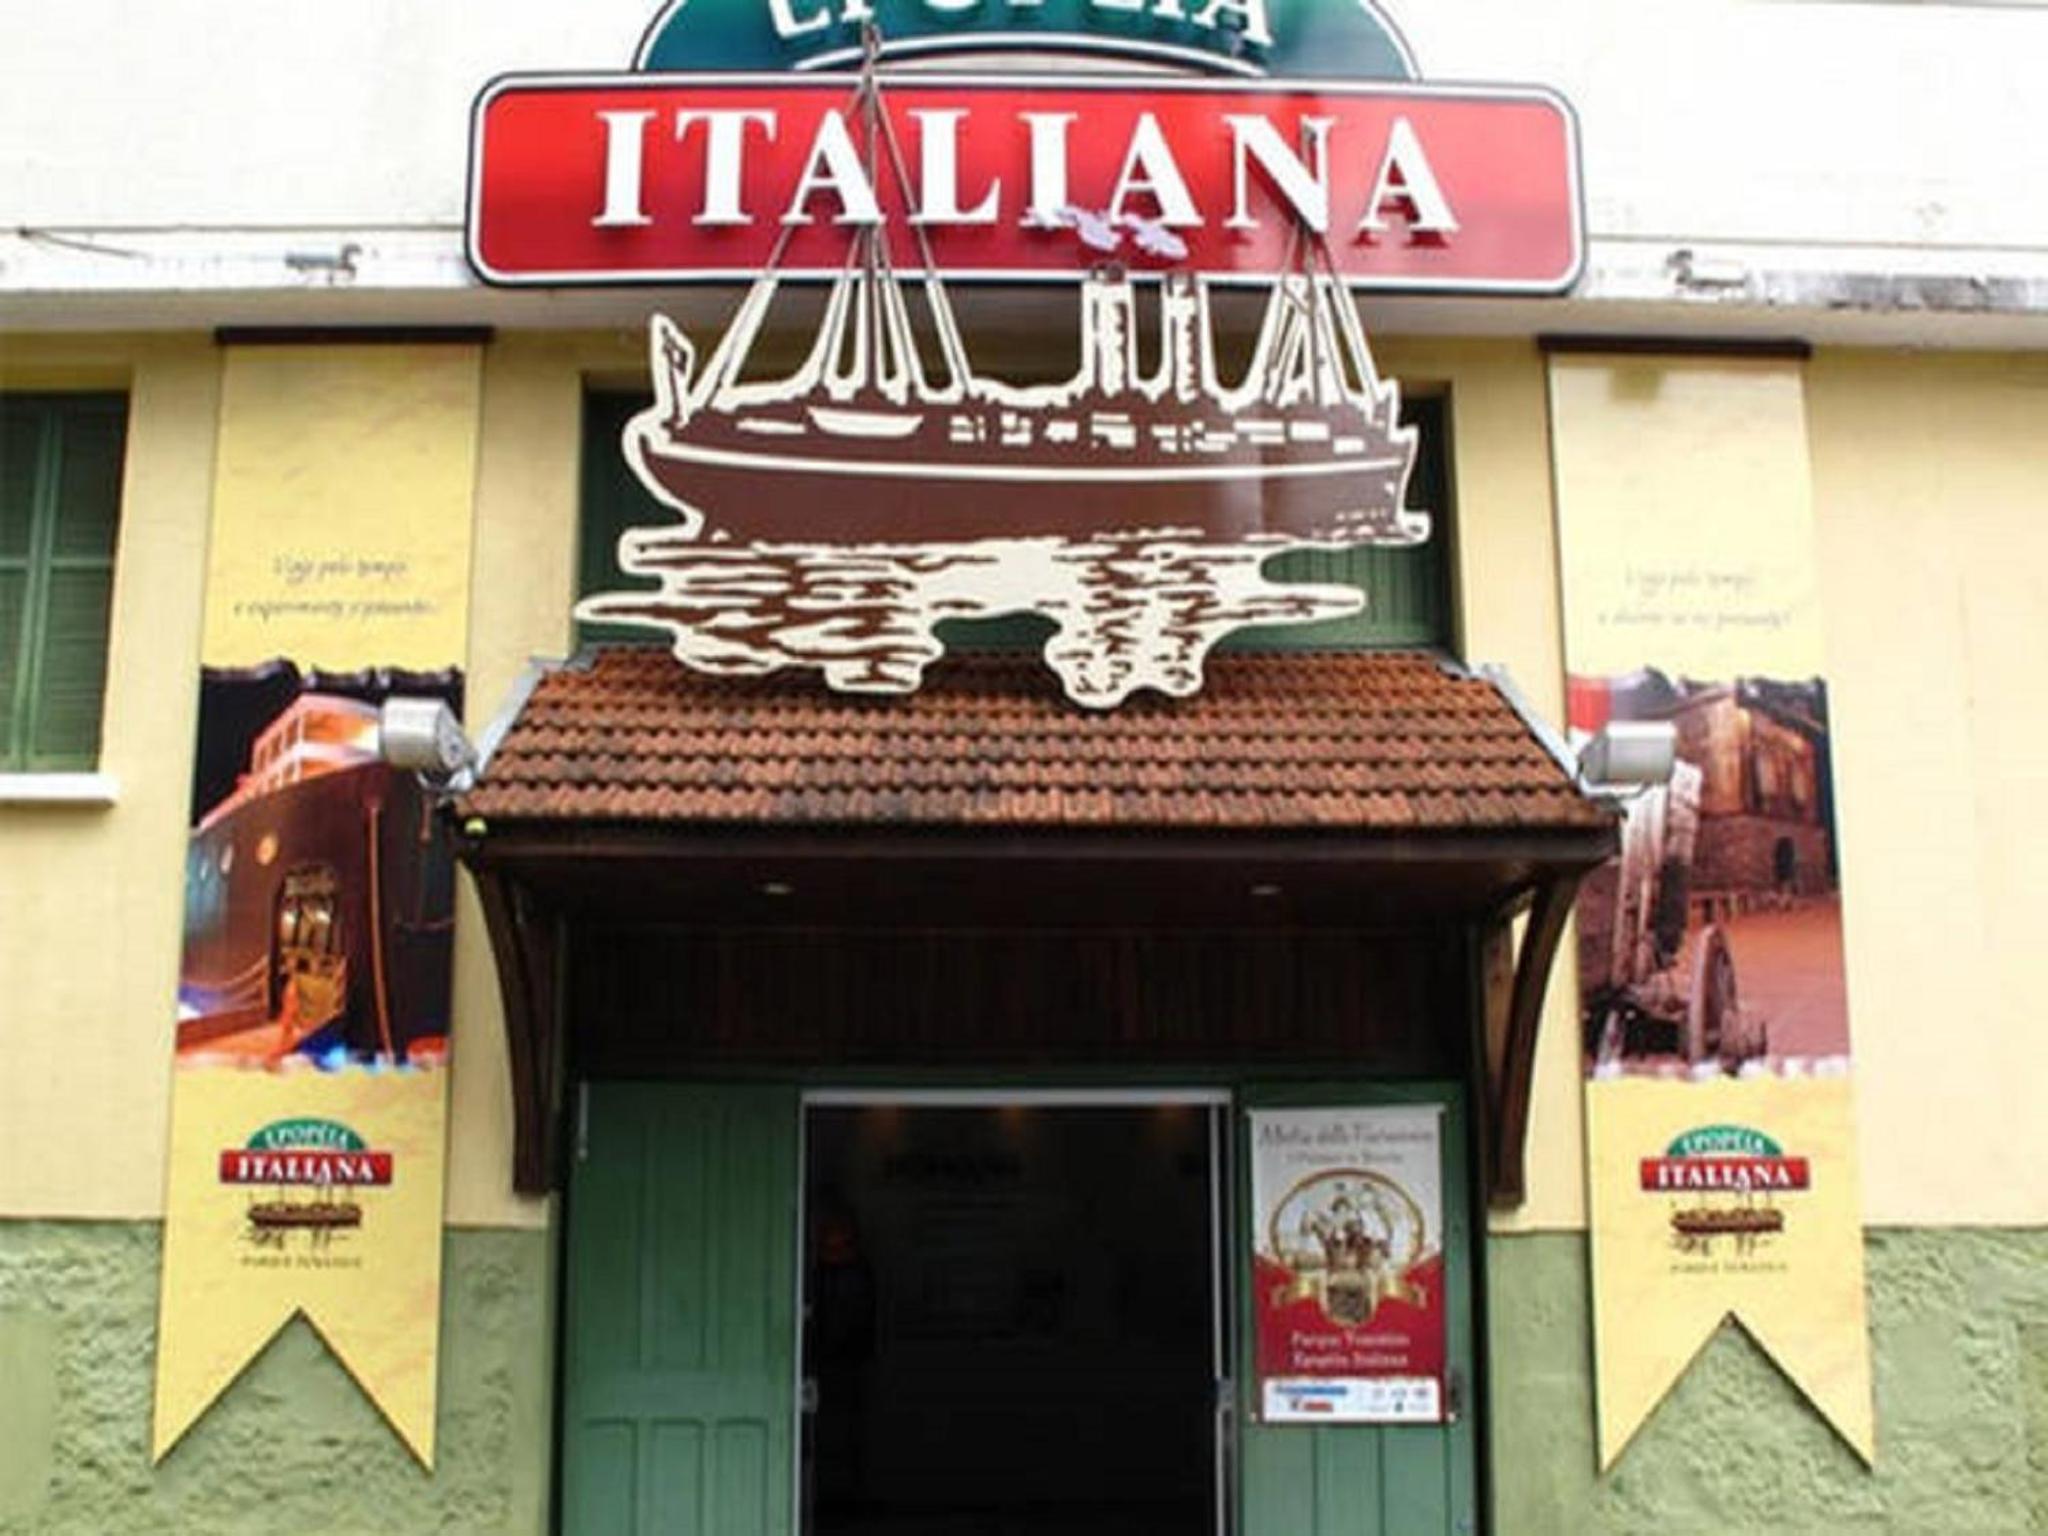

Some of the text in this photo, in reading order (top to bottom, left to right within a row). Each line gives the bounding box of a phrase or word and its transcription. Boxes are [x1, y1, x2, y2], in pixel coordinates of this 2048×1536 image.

[591, 107, 1461, 237] ITALIANA
[238, 1156, 374, 1182] ITALIANA
[1657, 1164, 1792, 1188] ITALIANA
